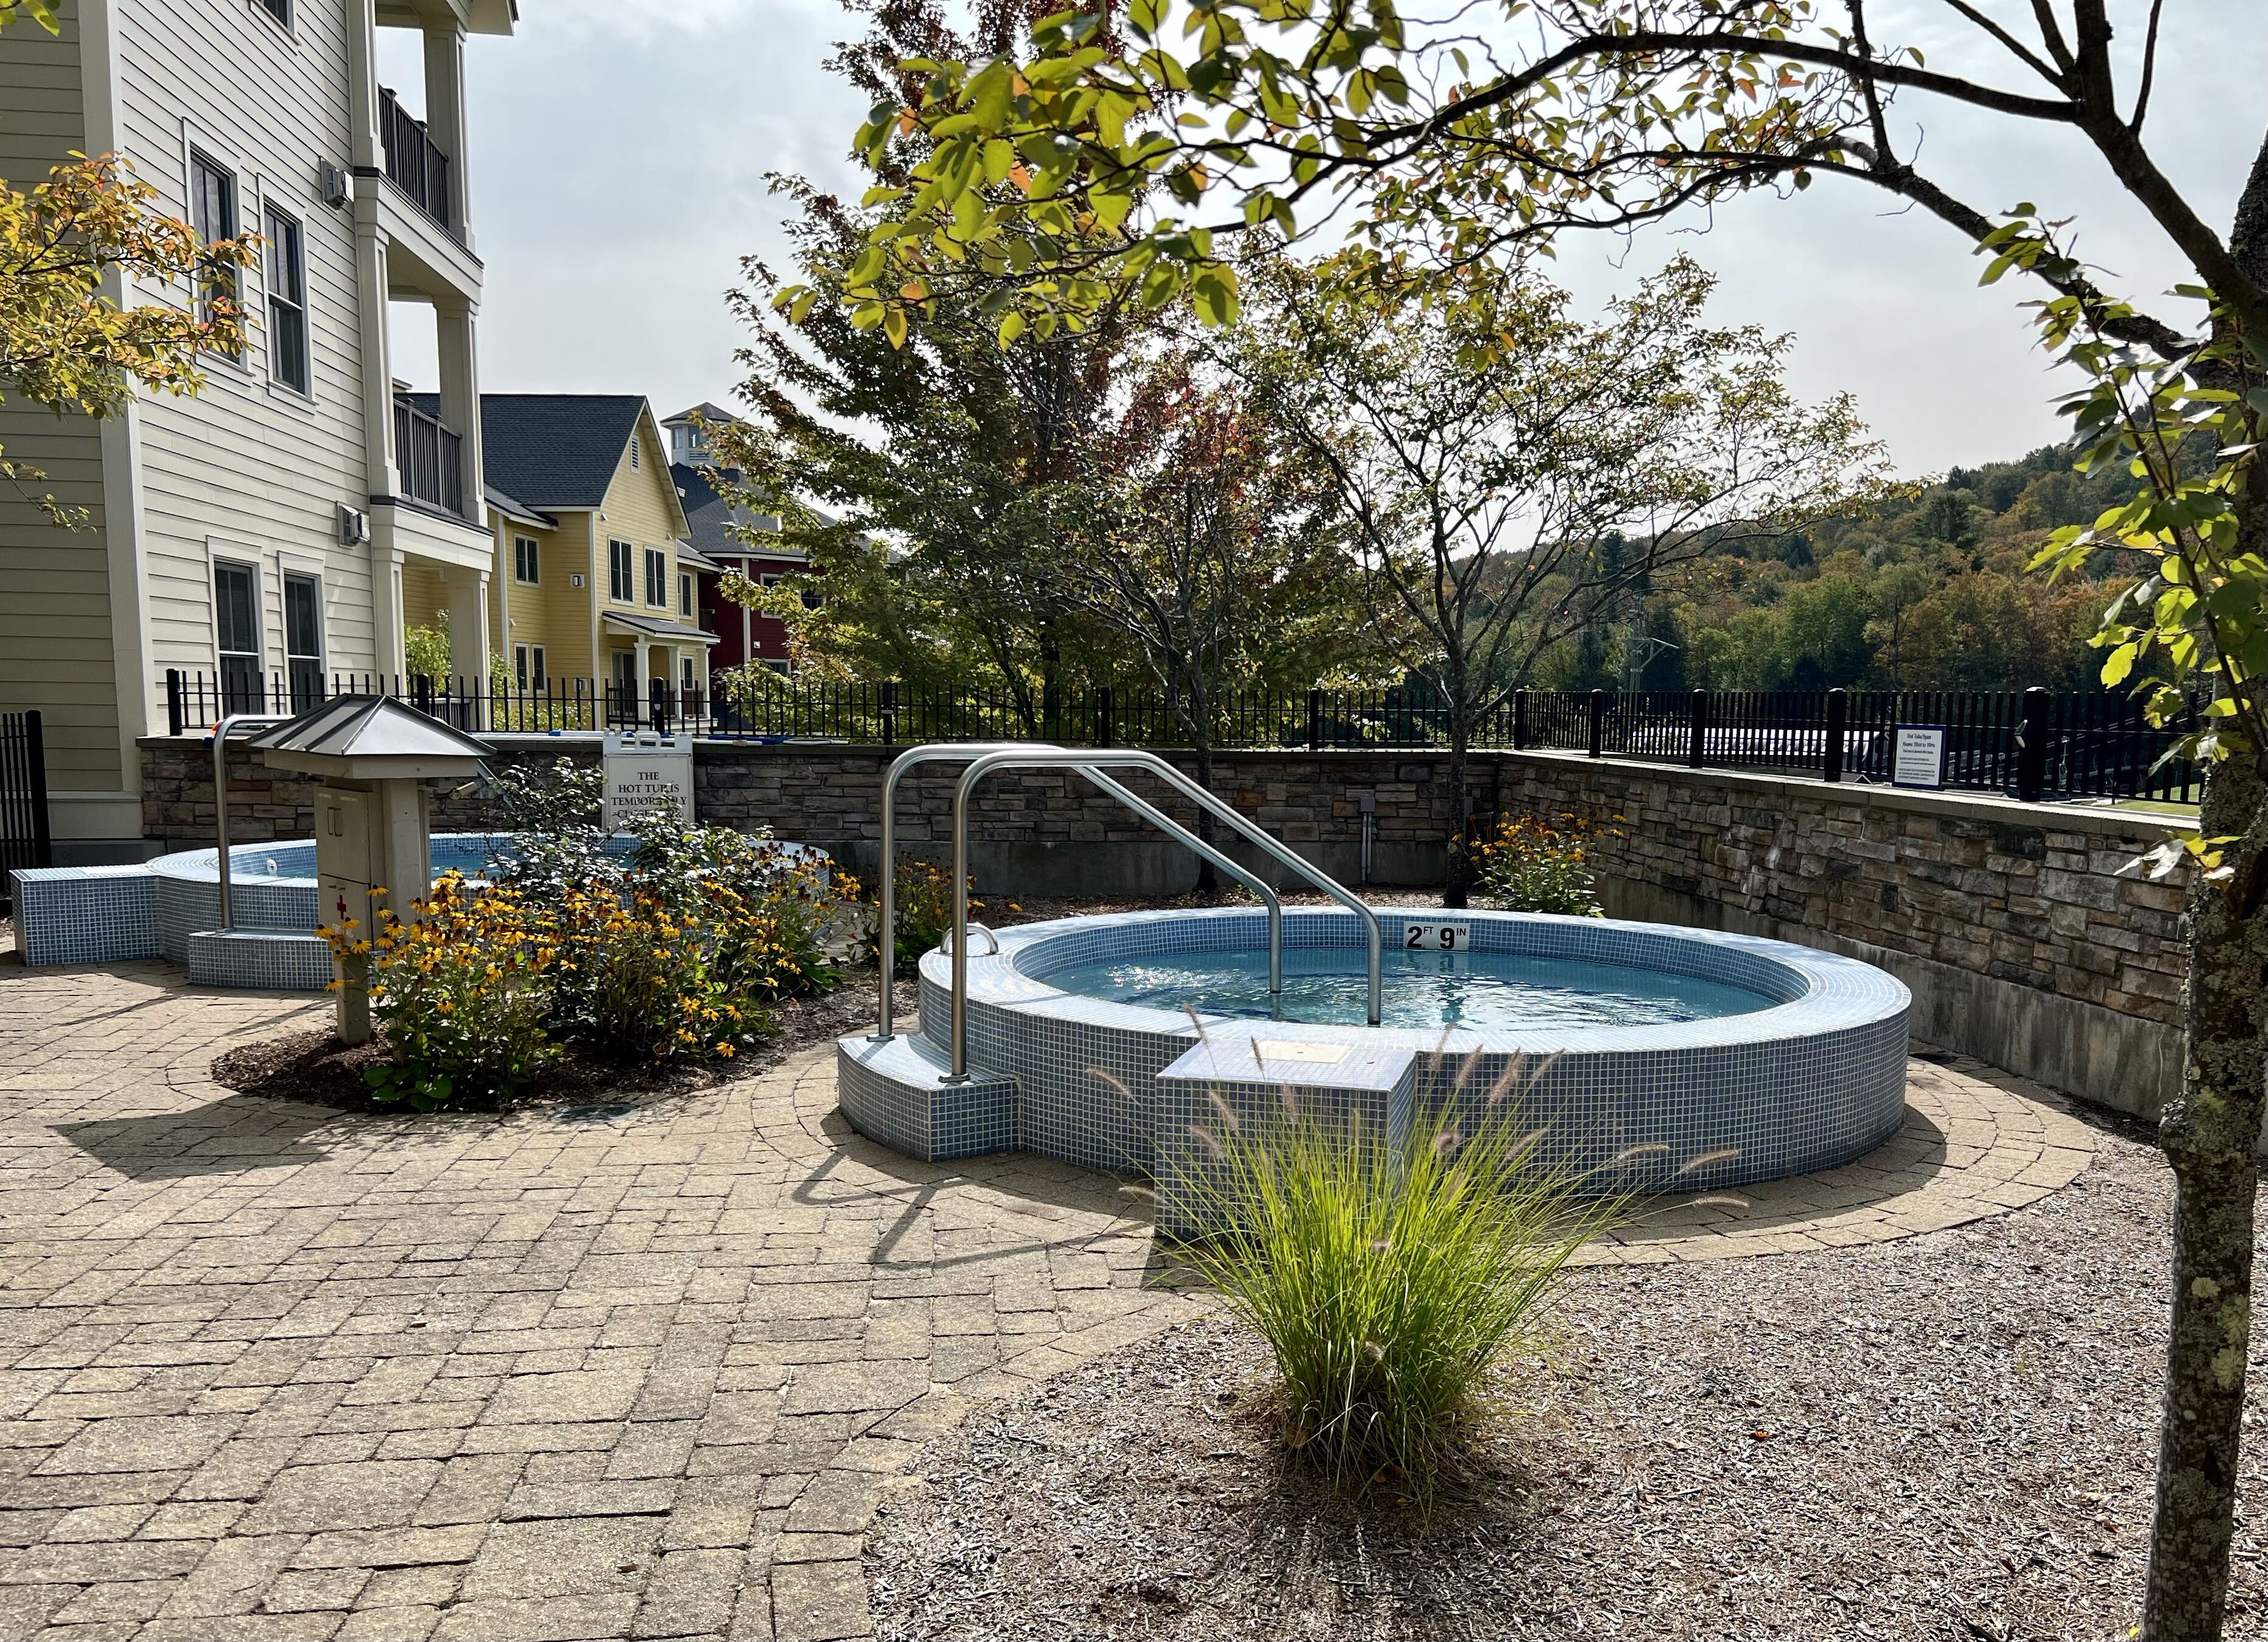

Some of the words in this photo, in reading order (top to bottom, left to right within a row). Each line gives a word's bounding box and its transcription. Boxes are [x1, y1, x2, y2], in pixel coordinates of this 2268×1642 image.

[637, 771, 659, 781] THE
[619, 784, 642, 793] HOT
[670, 784, 679, 793] IS
[611, 796, 687, 806] TEMPORLY
